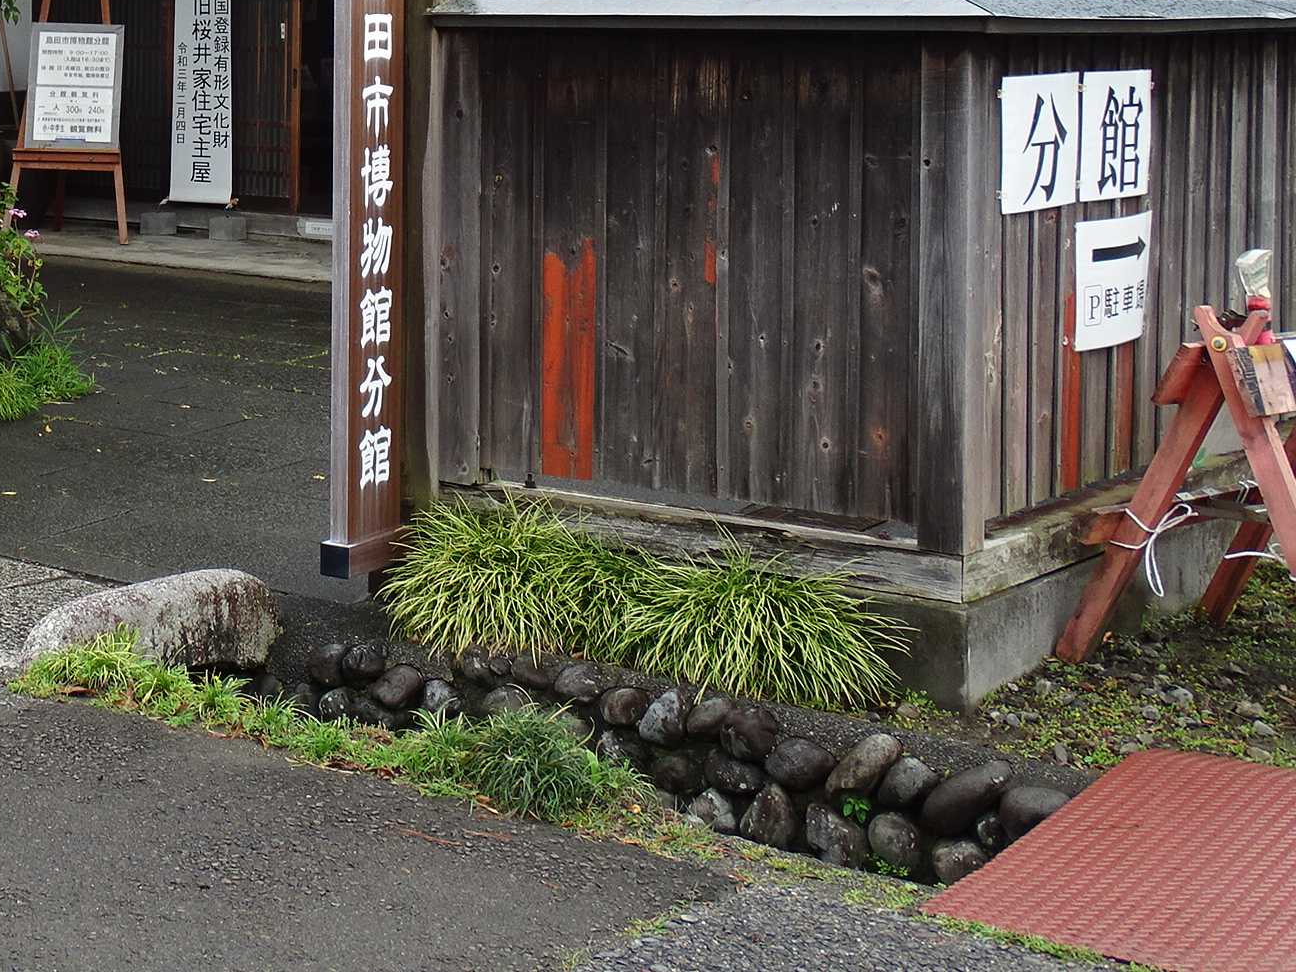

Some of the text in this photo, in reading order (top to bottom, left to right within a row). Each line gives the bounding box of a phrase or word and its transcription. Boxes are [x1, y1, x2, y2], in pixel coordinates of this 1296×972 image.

[175, 42, 188, 144] 令和三年二月四日
[1022, 85, 1144, 205] 分館
[1089, 294, 1101, 320] P
